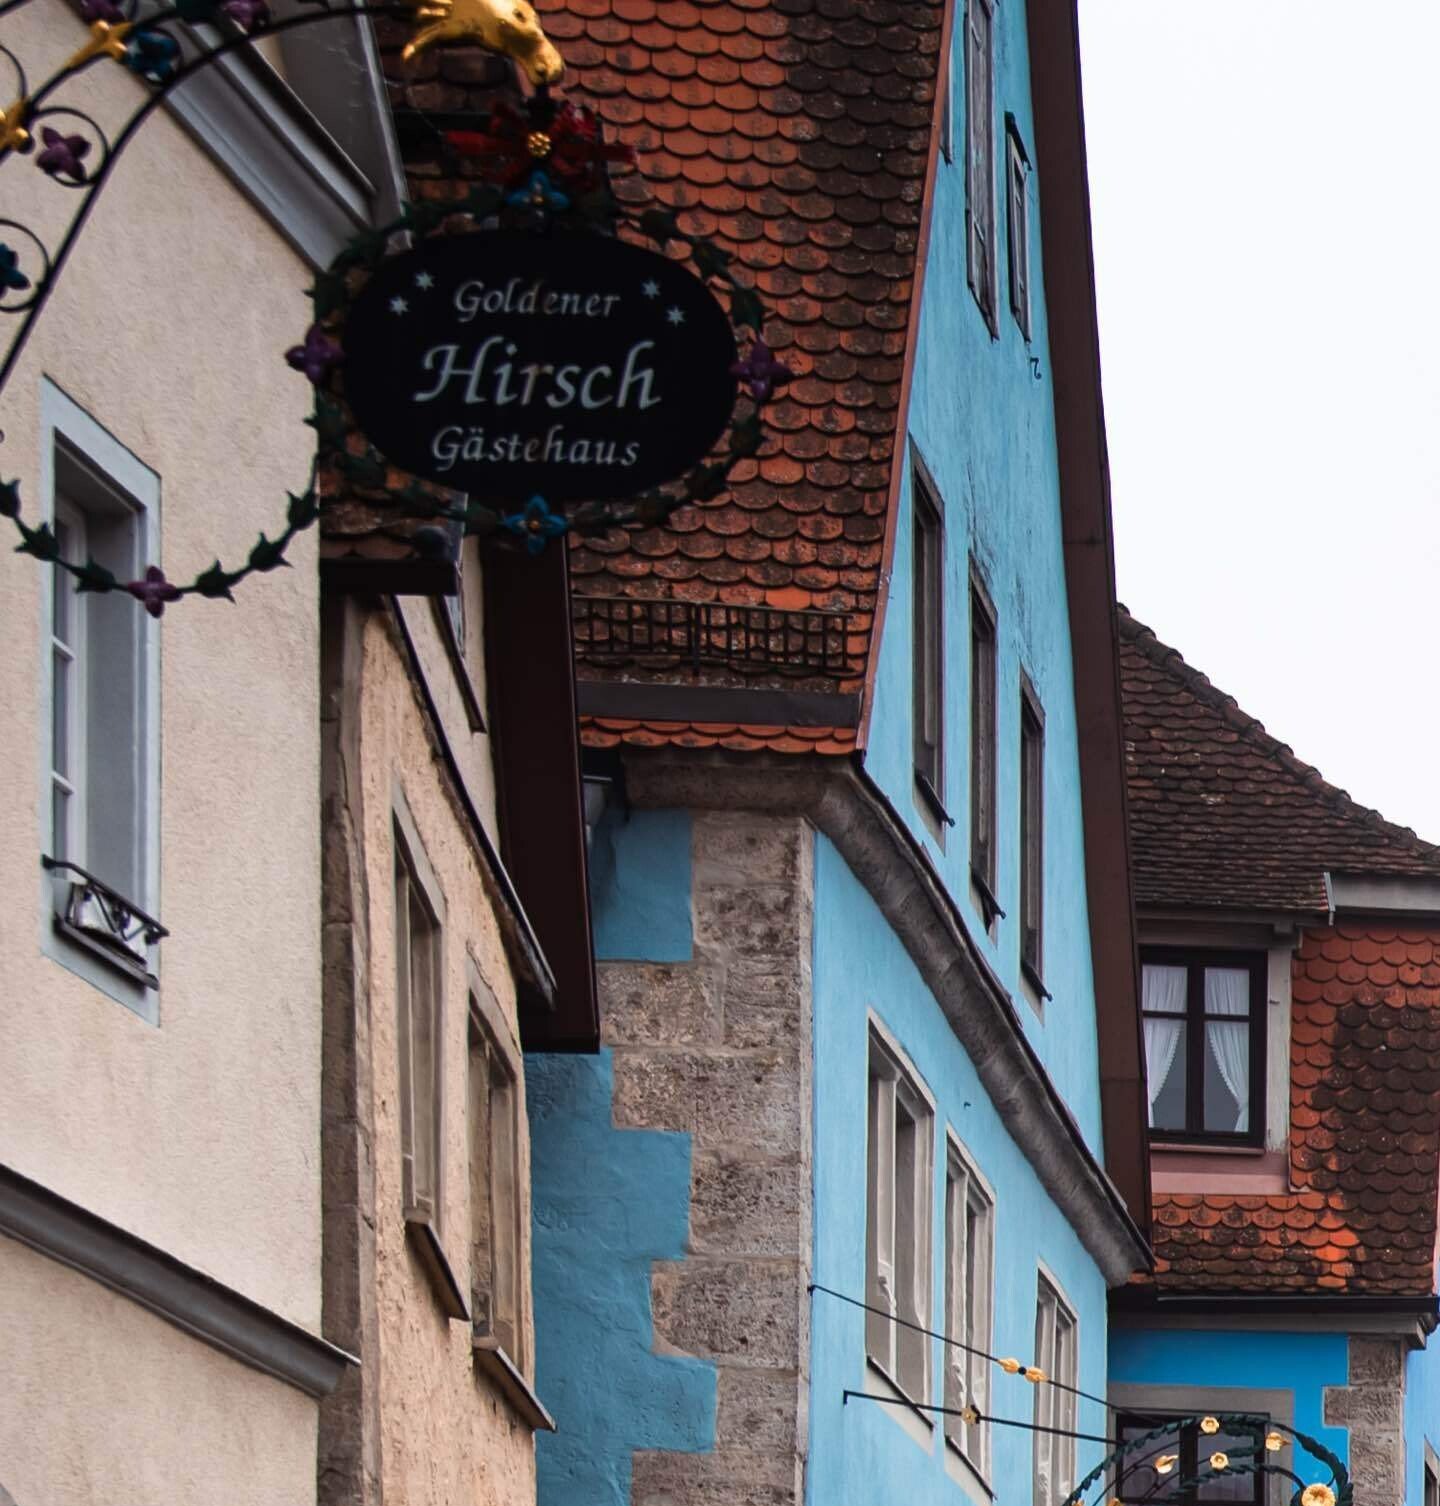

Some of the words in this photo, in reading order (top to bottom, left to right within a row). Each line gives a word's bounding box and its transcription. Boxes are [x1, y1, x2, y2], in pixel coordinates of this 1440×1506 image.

[454, 278, 621, 323] Goldener
[414, 336, 662, 410] Hirsch
[431, 424, 641, 473] Gästehaus
